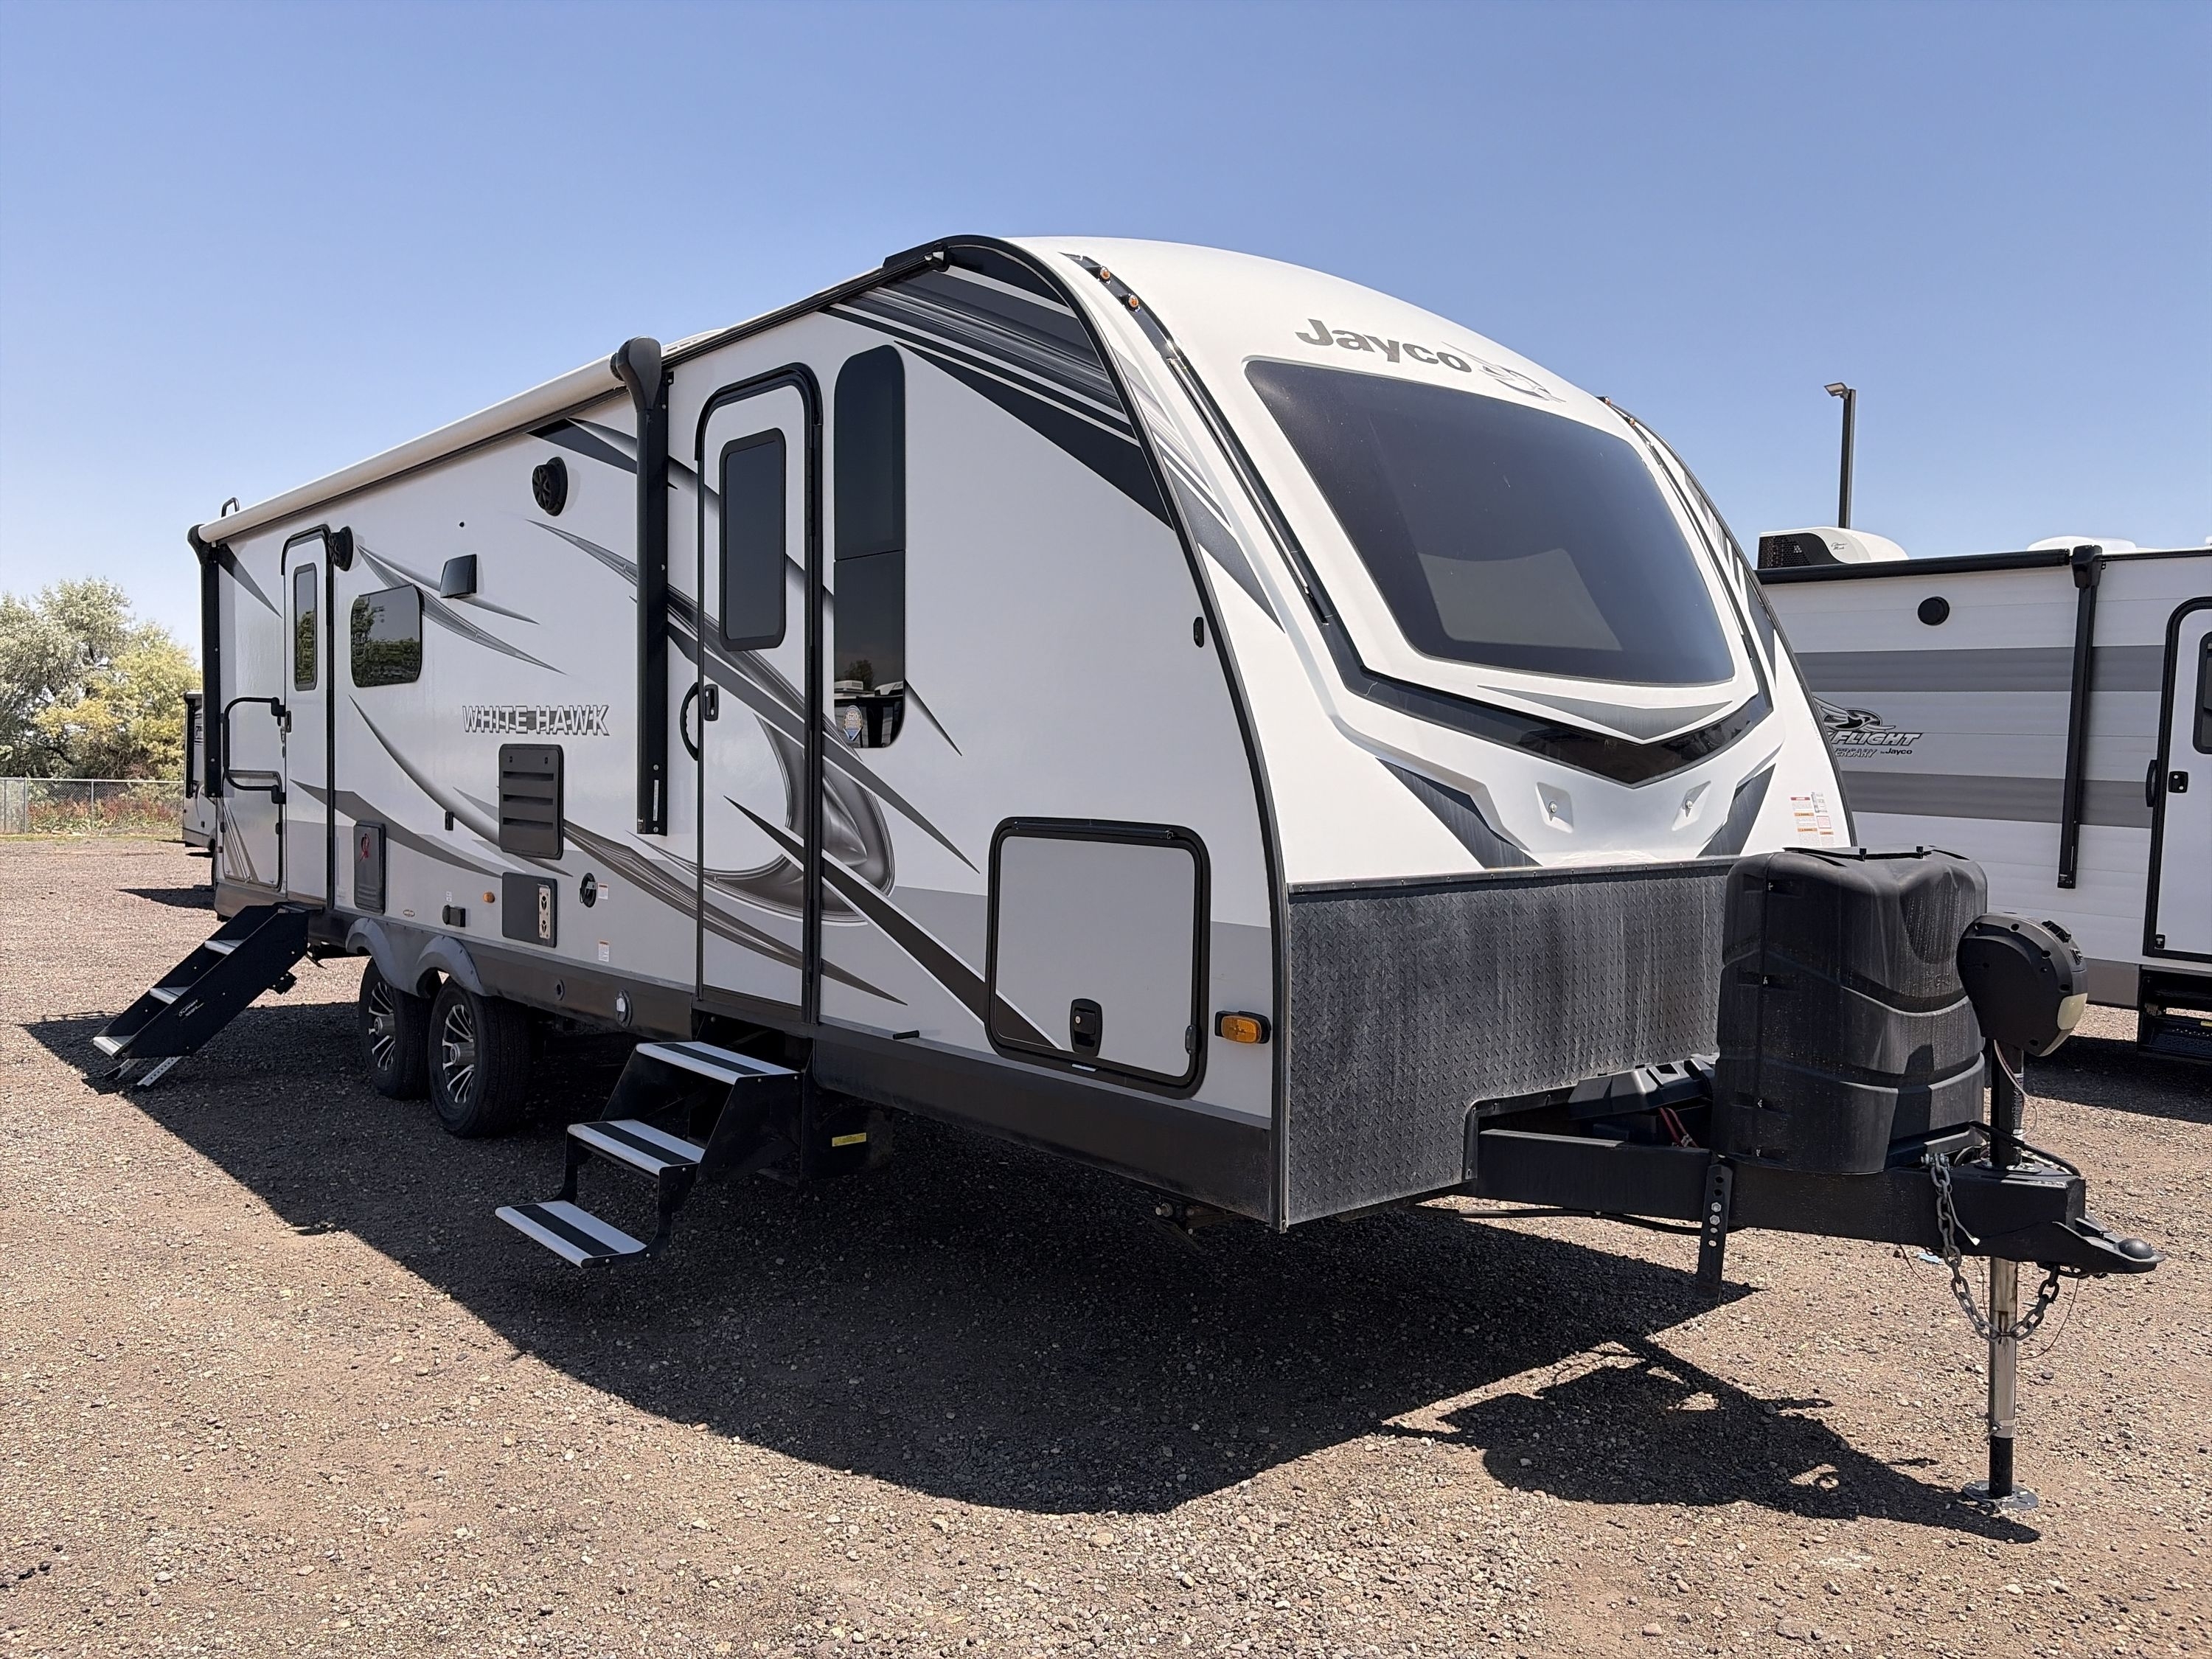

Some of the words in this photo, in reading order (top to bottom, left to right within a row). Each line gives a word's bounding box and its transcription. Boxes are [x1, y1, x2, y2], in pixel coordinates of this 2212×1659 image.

[1295, 319, 1472, 372] Jayco
[462, 705, 529, 734] WHITE
[536, 705, 610, 736] HAWK
[1885, 748, 1913, 756] Jayco
